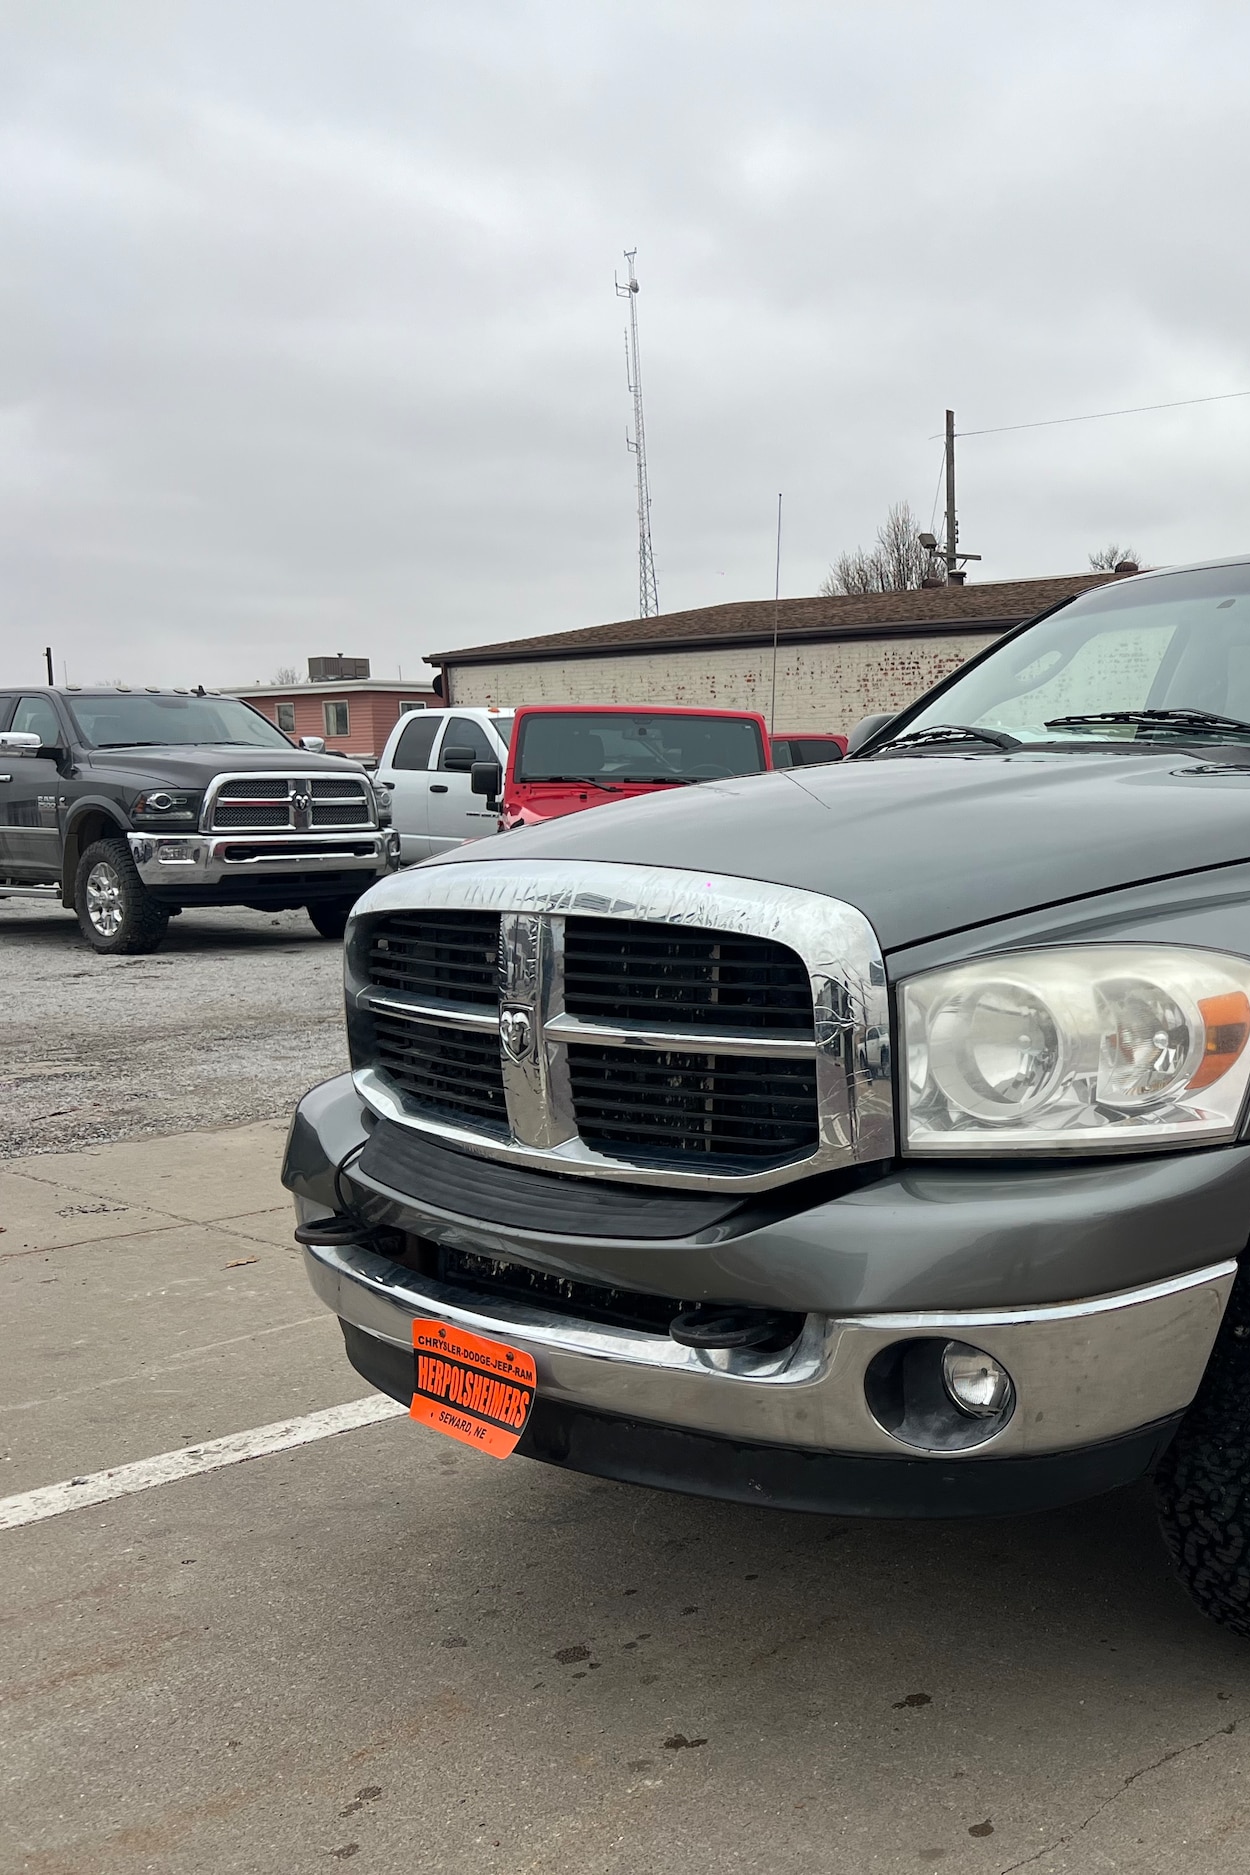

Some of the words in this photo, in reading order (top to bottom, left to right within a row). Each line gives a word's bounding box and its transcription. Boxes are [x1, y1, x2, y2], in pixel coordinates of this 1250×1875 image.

[417, 1356, 530, 1428] HERPOLSHEIMERS
[438, 1410, 472, 1436] SEWARD,
[474, 1426, 488, 1439] NE
